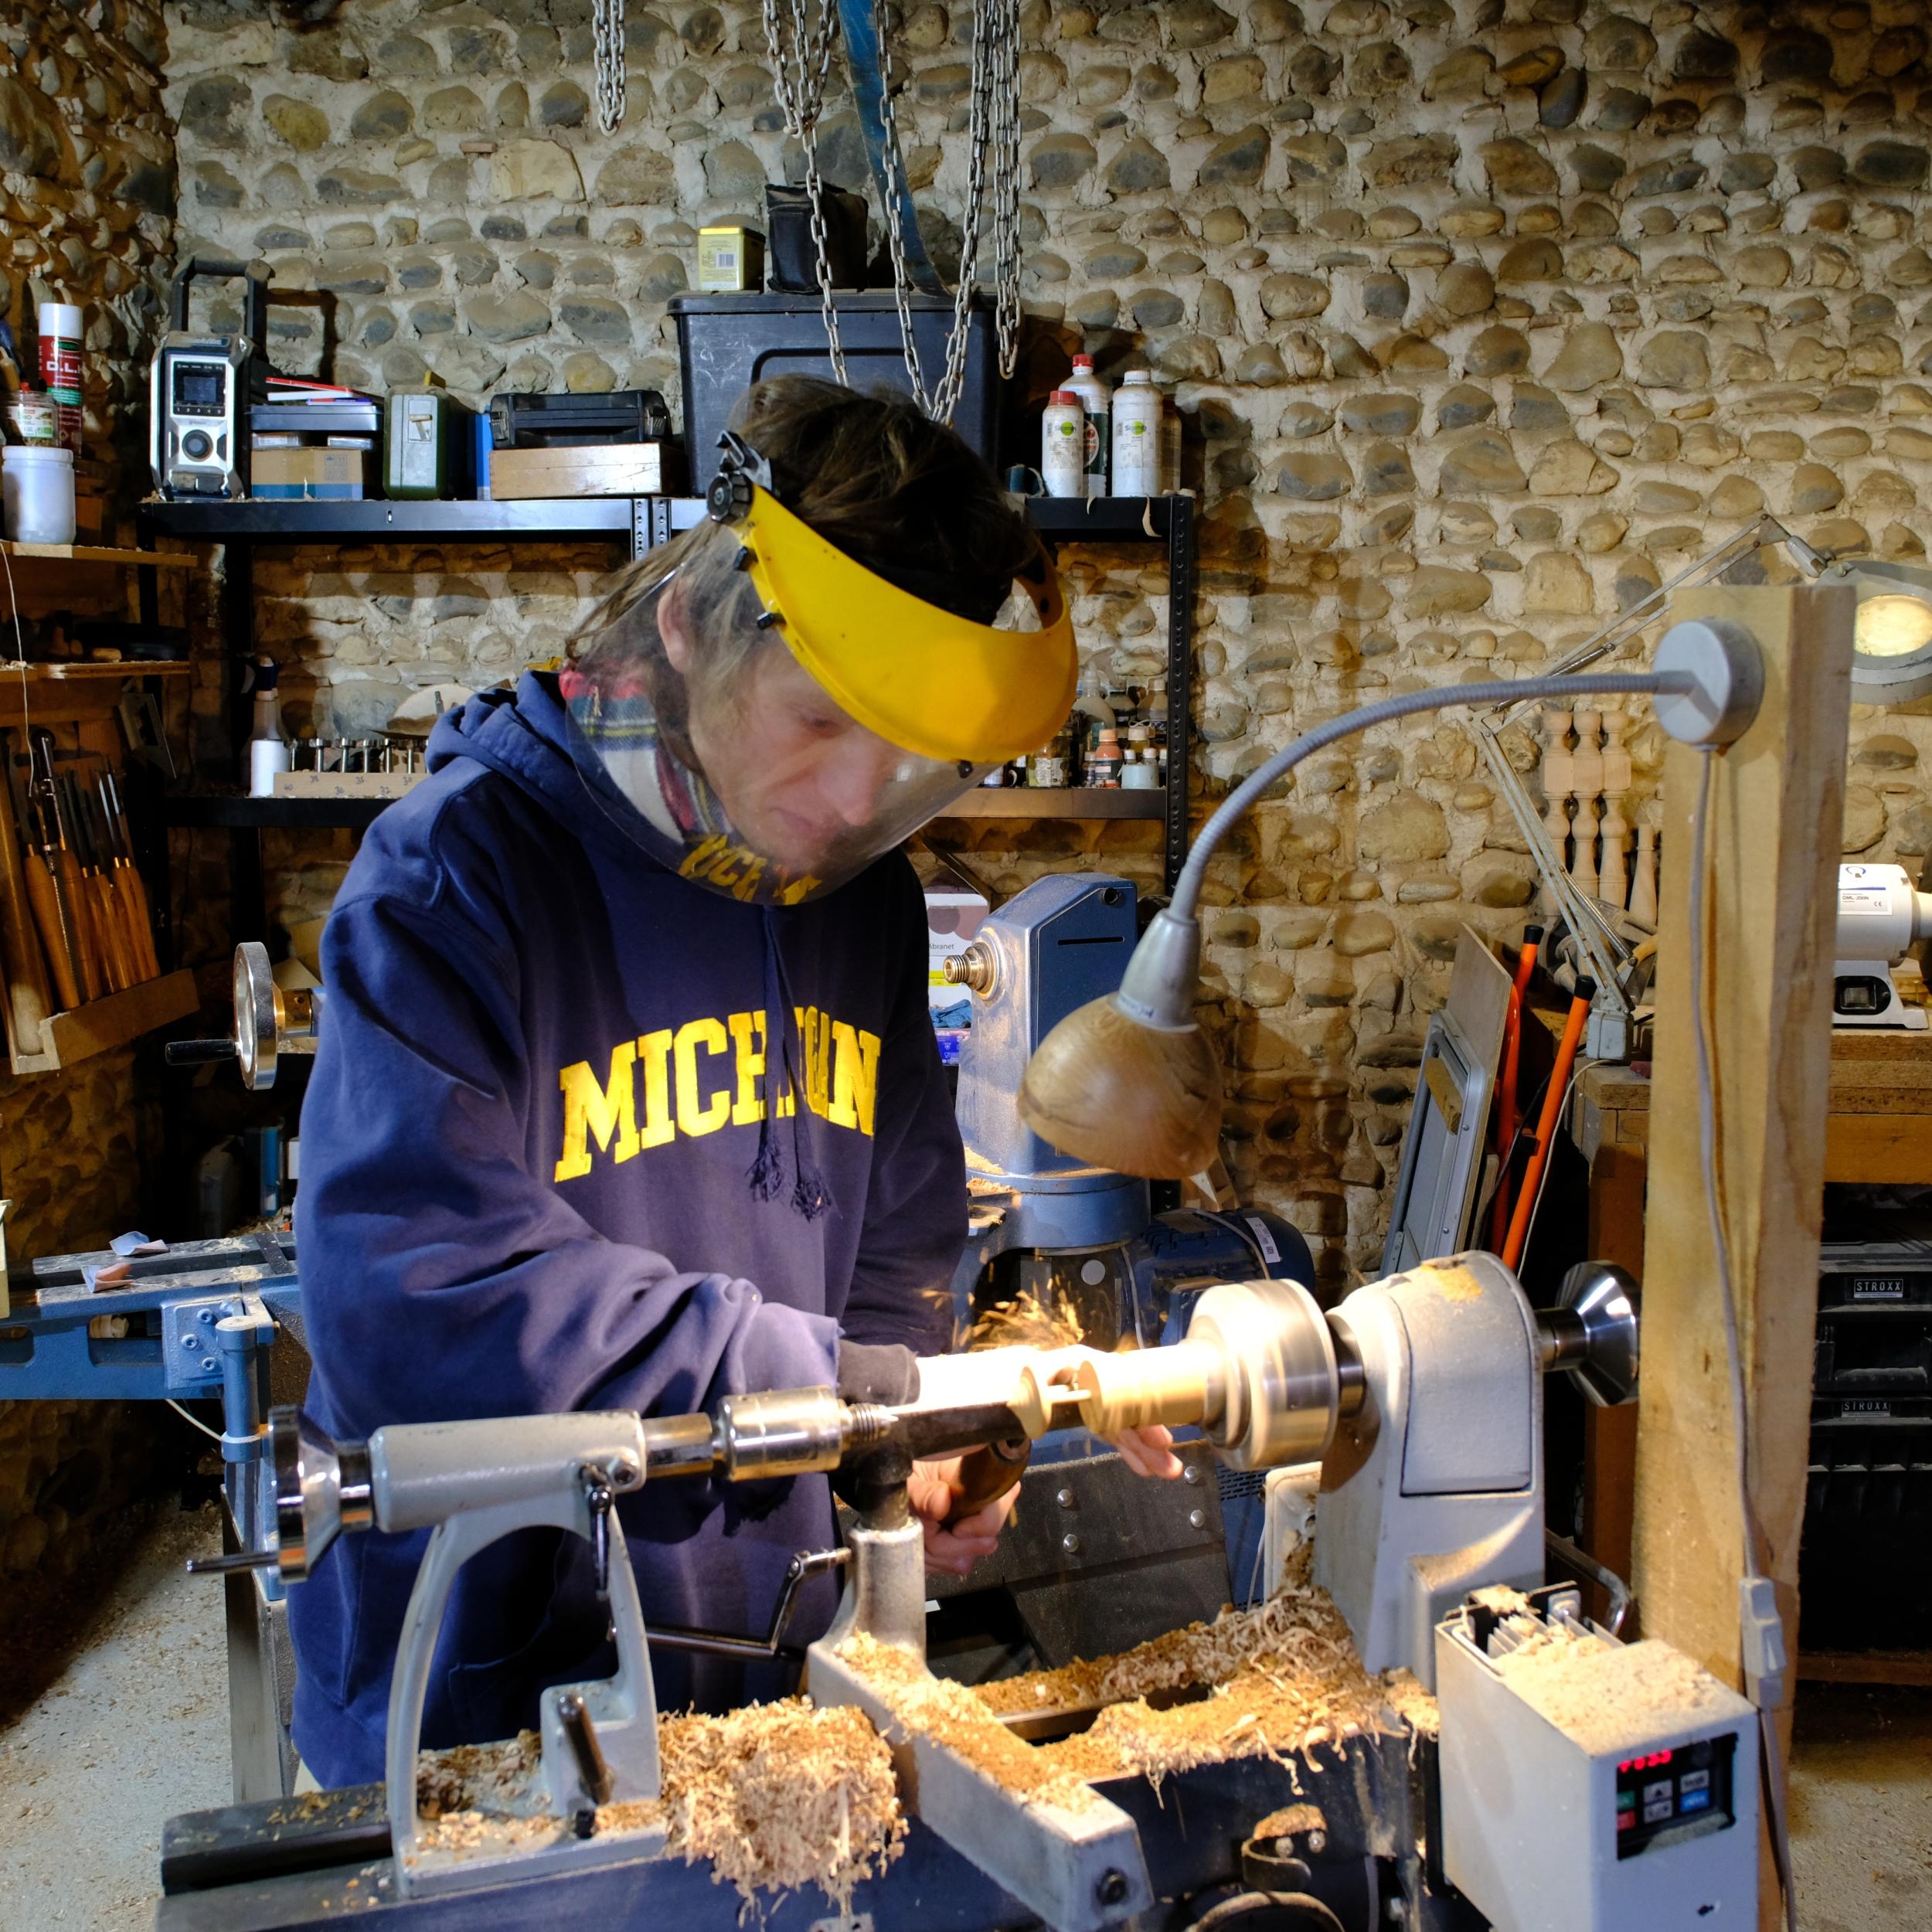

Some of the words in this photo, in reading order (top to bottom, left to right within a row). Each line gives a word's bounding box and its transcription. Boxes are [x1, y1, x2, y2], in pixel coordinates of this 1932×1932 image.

[403, 776, 413, 785] 30
[284, 783, 294, 791] 40
[555, 1005, 881, 1182] MICHN
[1856, 1281, 1900, 1291] STROXX
